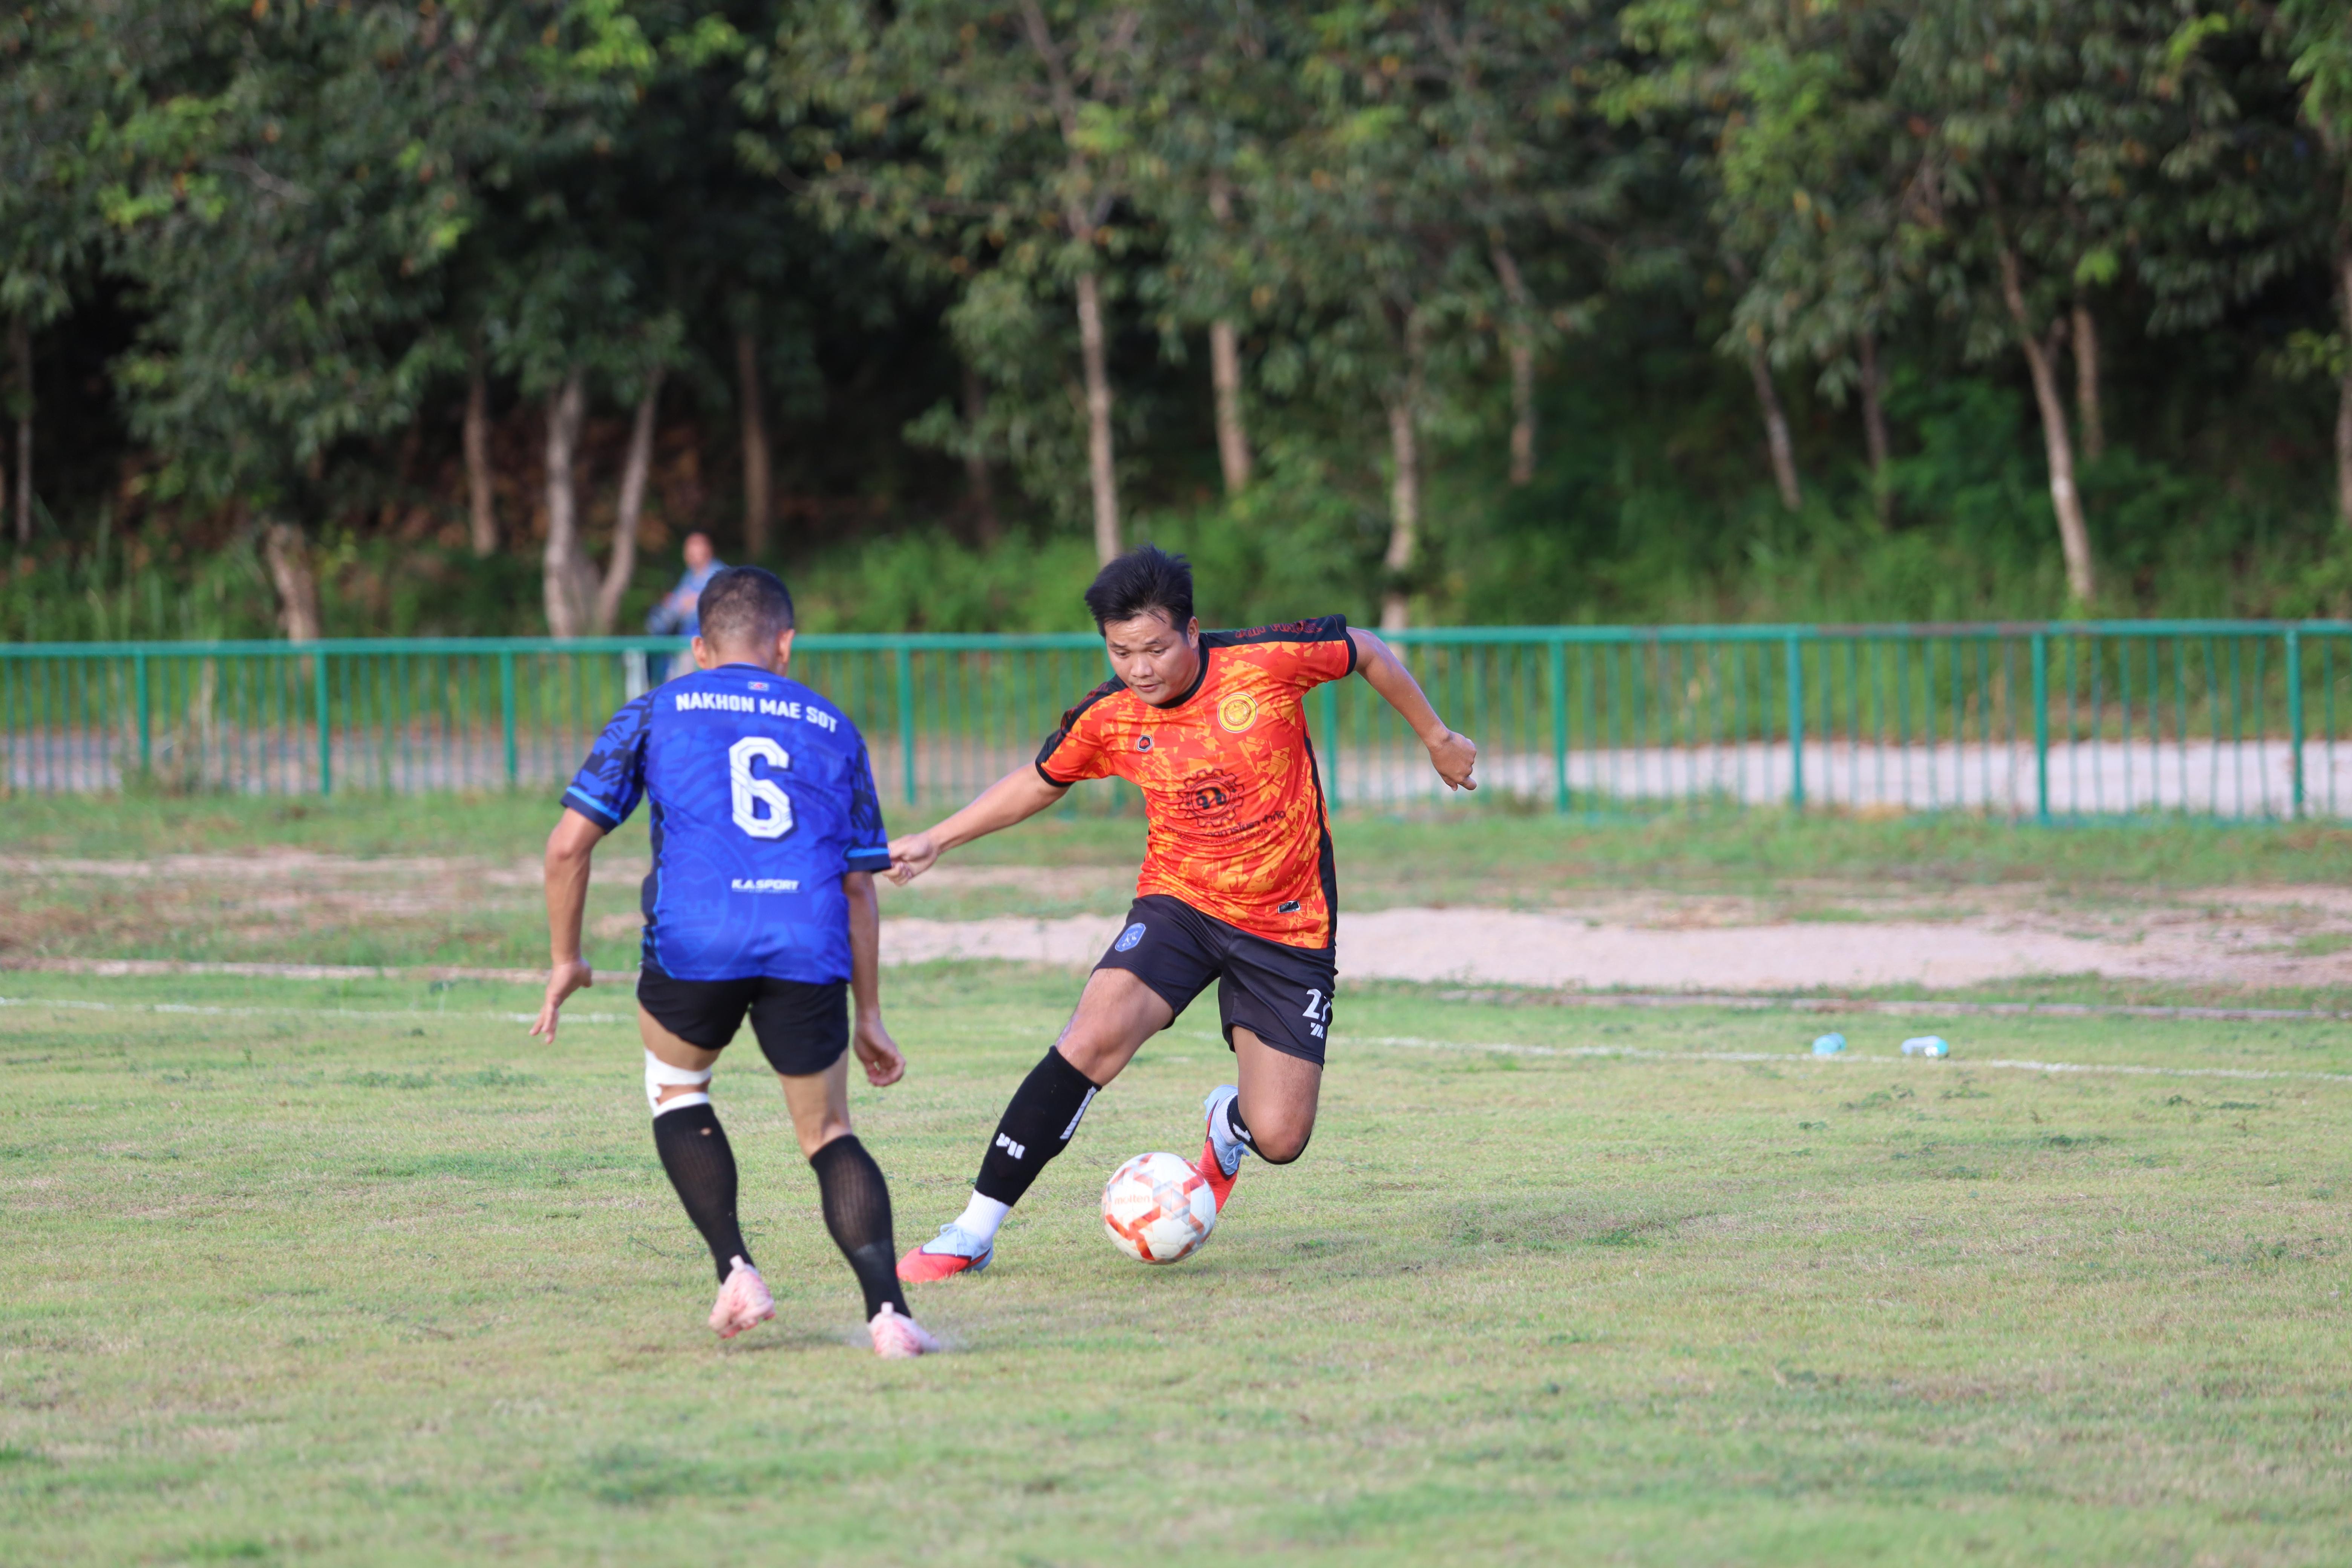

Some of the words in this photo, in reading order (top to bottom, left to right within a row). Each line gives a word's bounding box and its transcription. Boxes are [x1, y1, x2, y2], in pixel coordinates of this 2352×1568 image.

[676, 692, 755, 712] NAKHON
[760, 698, 802, 719] MAE
[805, 706, 838, 733] SOT
[729, 737, 793, 839] 6
[1115, 1194, 1150, 1205] molten
